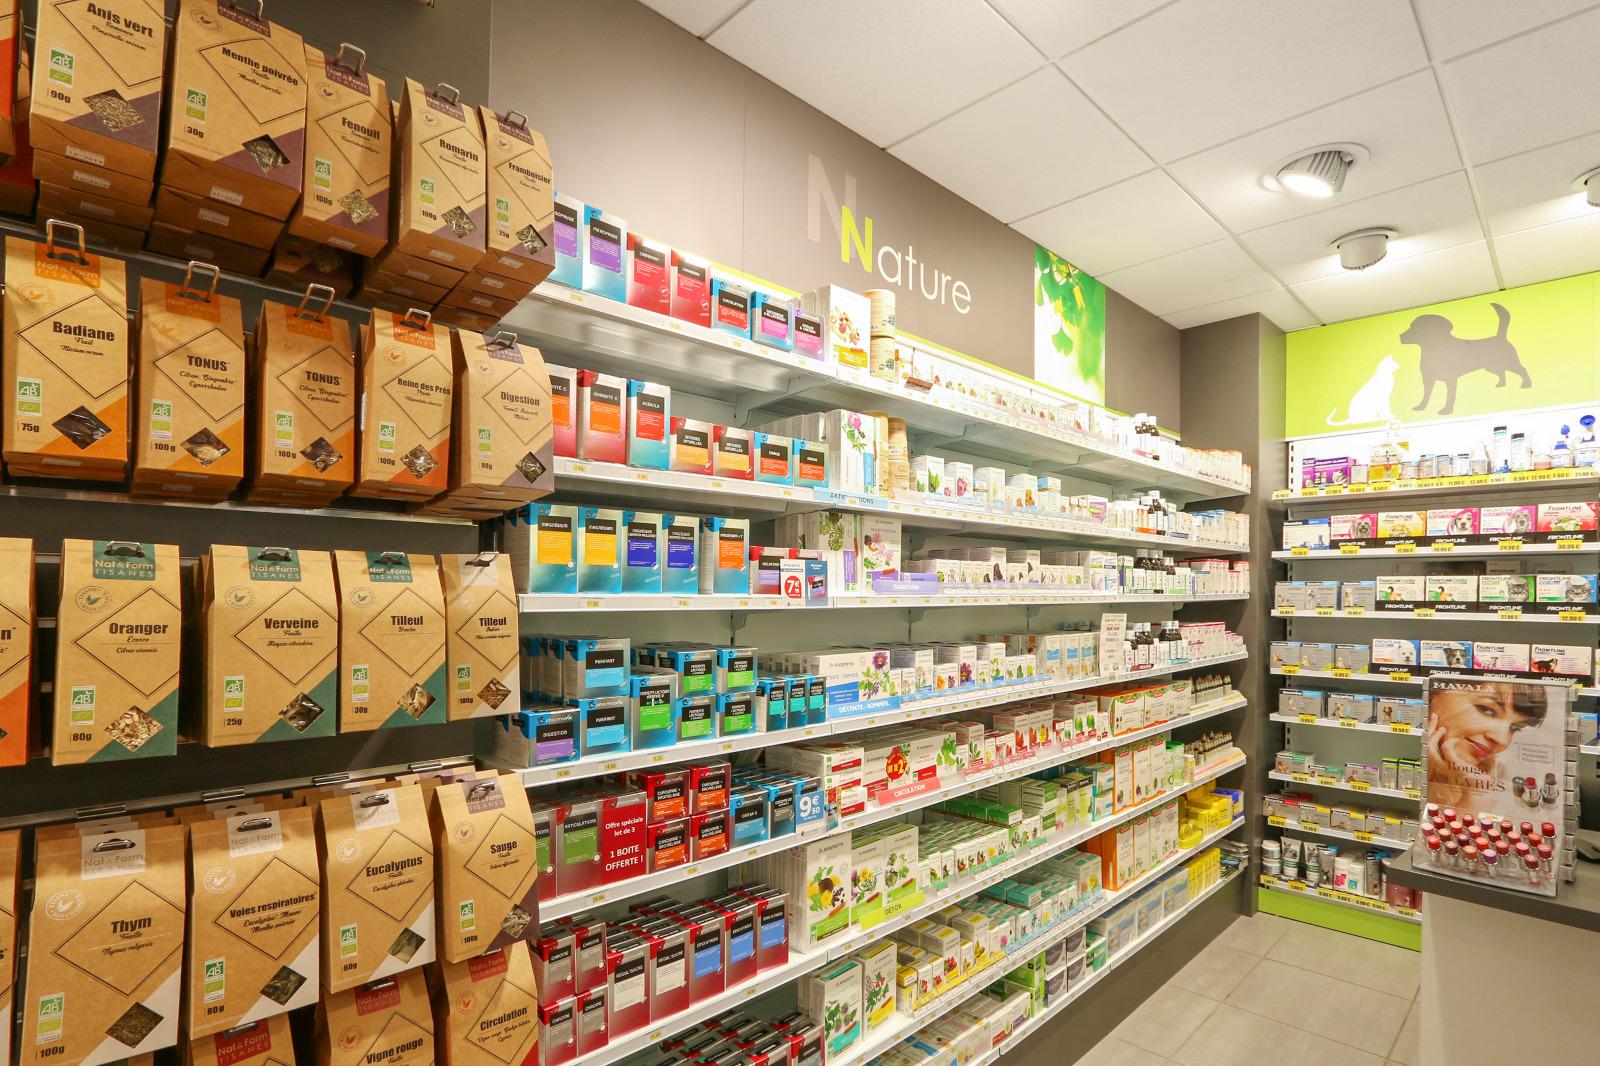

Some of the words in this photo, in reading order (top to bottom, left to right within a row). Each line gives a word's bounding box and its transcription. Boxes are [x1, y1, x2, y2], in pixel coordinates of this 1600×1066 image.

[86, 2, 121, 27] Anis
[123, 17, 155, 39] vert
[222, 46, 262, 70] Menthe
[261, 62, 300, 87] poivrée
[49, 89, 72, 105] 90g
[186, 126, 205, 140] 30g
[341, 116, 381, 141] Fenouil
[439, 138, 480, 163] Romarin
[508, 161, 552, 186] Framboisier
[315, 193, 333, 208] 100g
[421, 209, 438, 223] 100g
[840, 204, 972, 315] Nature
[53, 321, 116, 343] Badiane
[186, 355, 228, 373] TONUS
[305, 370, 342, 387] TONUS
[397, 377, 419, 392] Reine
[418, 381, 434, 393] des
[433, 383, 452, 396] Prés
[500, 391, 540, 408] Digestion
[21, 422, 41, 434] 75g
[379, 456, 396, 467] 100g
[94, 559, 154, 571] Nat&Form
[250, 564, 300, 574] Nat&Form
[94, 569, 154, 579] TISANES
[108, 621, 169, 637] Oranger
[264, 617, 320, 630] Verveine
[391, 615, 425, 627] Tilleul
[479, 616, 508, 629] Tilleul
[353, 705, 369, 716] 30g
[838, 703, 865, 714] DÉTENTE
[226, 716, 243, 727] 25g
[72, 731, 92, 743] 80g
[893, 782, 927, 799] CIRCULATION
[605, 820, 622, 831] Offre
[621, 816, 645, 829] spéciale
[230, 831, 281, 847] Nat&Form
[613, 829, 624, 838] lot
[623, 828, 632, 836] de
[631, 826, 636, 834] 3
[490, 839, 518, 855] Sauge
[609, 850, 616, 860] 1
[84, 852, 144, 869] Nat&Form
[365, 856, 424, 879] Eucalyptus
[605, 857, 640, 873] OFFERTE
[229, 904, 257, 920] Voies
[256, 892, 315, 914] respiratoires
[884, 903, 903, 916] DETOX
[110, 914, 153, 935] Thym
[463, 934, 479, 945] 100g
[343, 961, 358, 973] 60g
[480, 1005, 530, 1032] Circulation
[40, 1043, 66, 1059] 100g
[366, 1045, 394, 1066] Vigne
[395, 1037, 425, 1056] rouge
